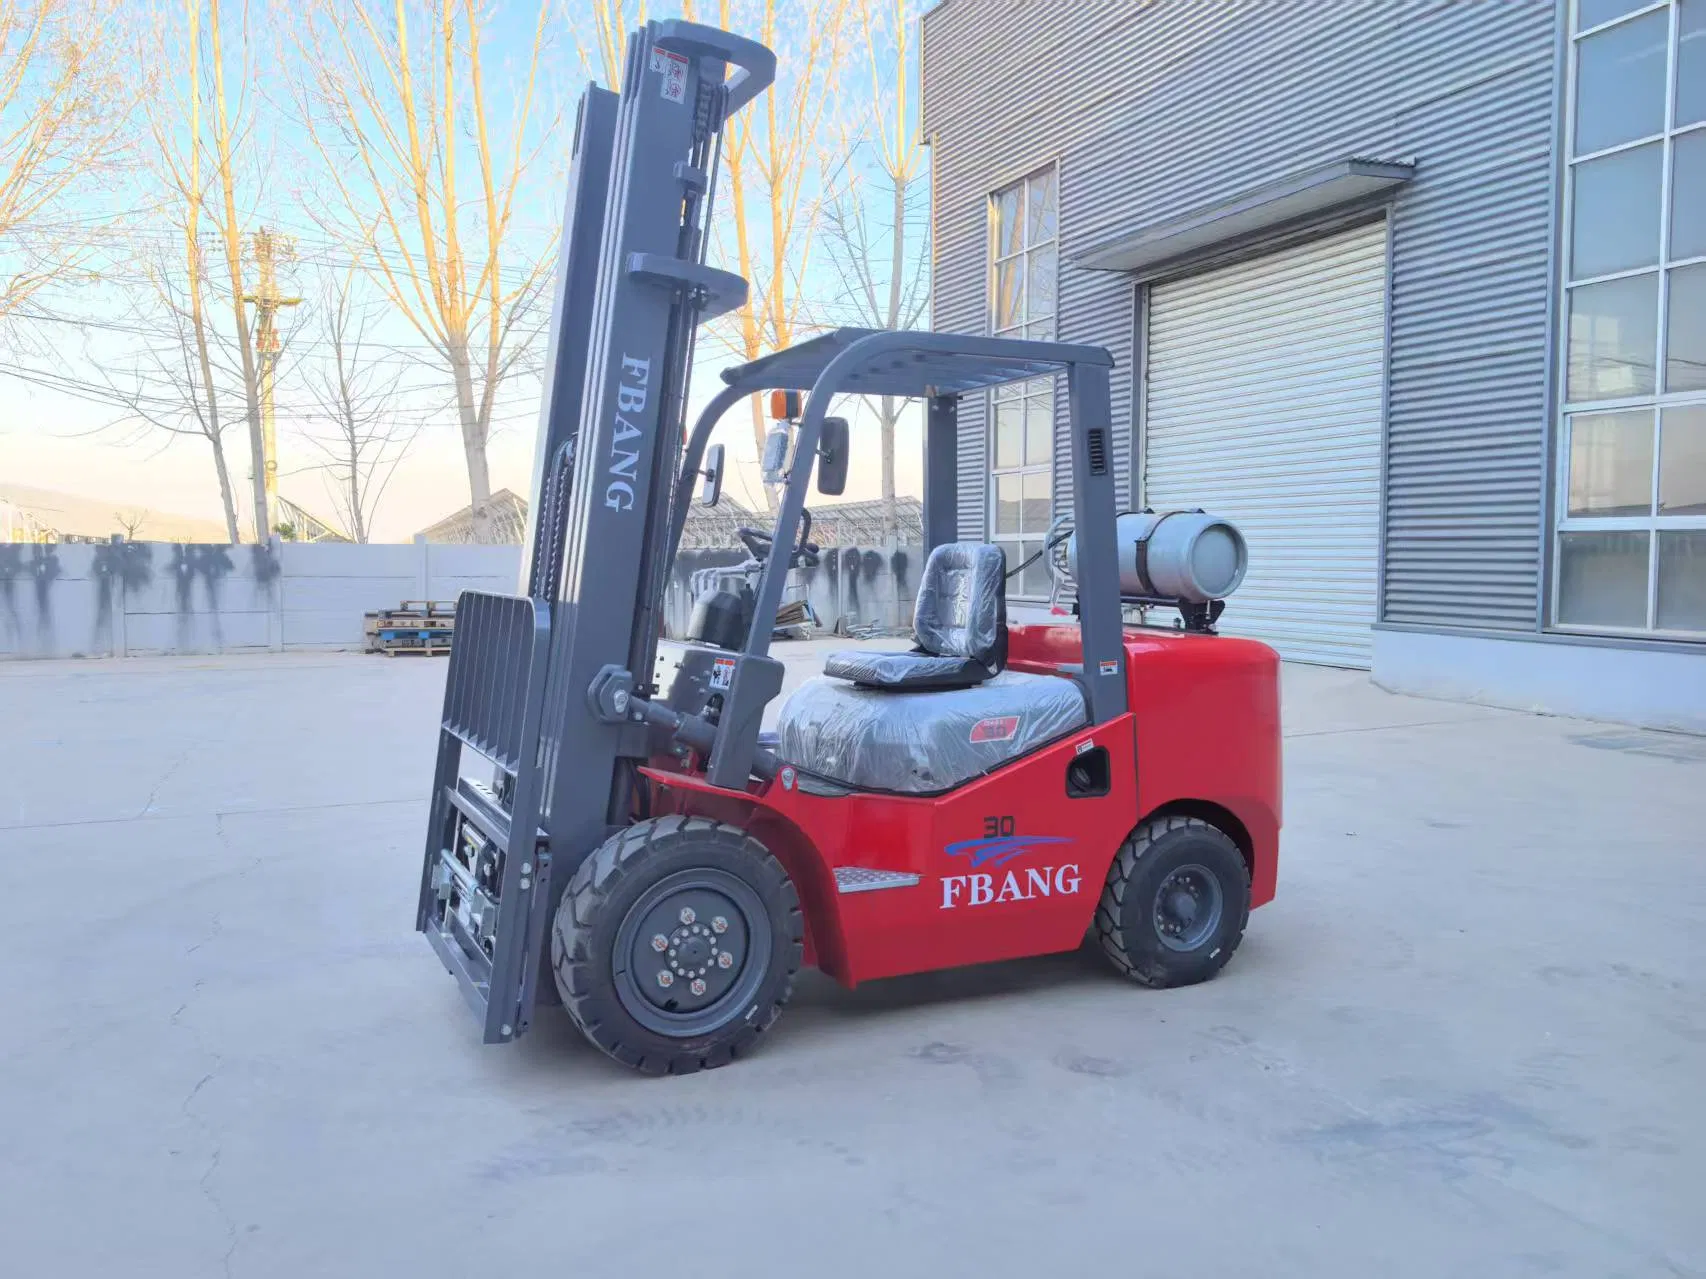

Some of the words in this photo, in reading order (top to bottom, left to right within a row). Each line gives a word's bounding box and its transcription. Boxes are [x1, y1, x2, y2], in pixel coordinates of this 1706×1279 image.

[605, 352, 650, 512] FBANG
[984, 816, 1014, 838] 30
[939, 864, 1082, 909] FBANG
